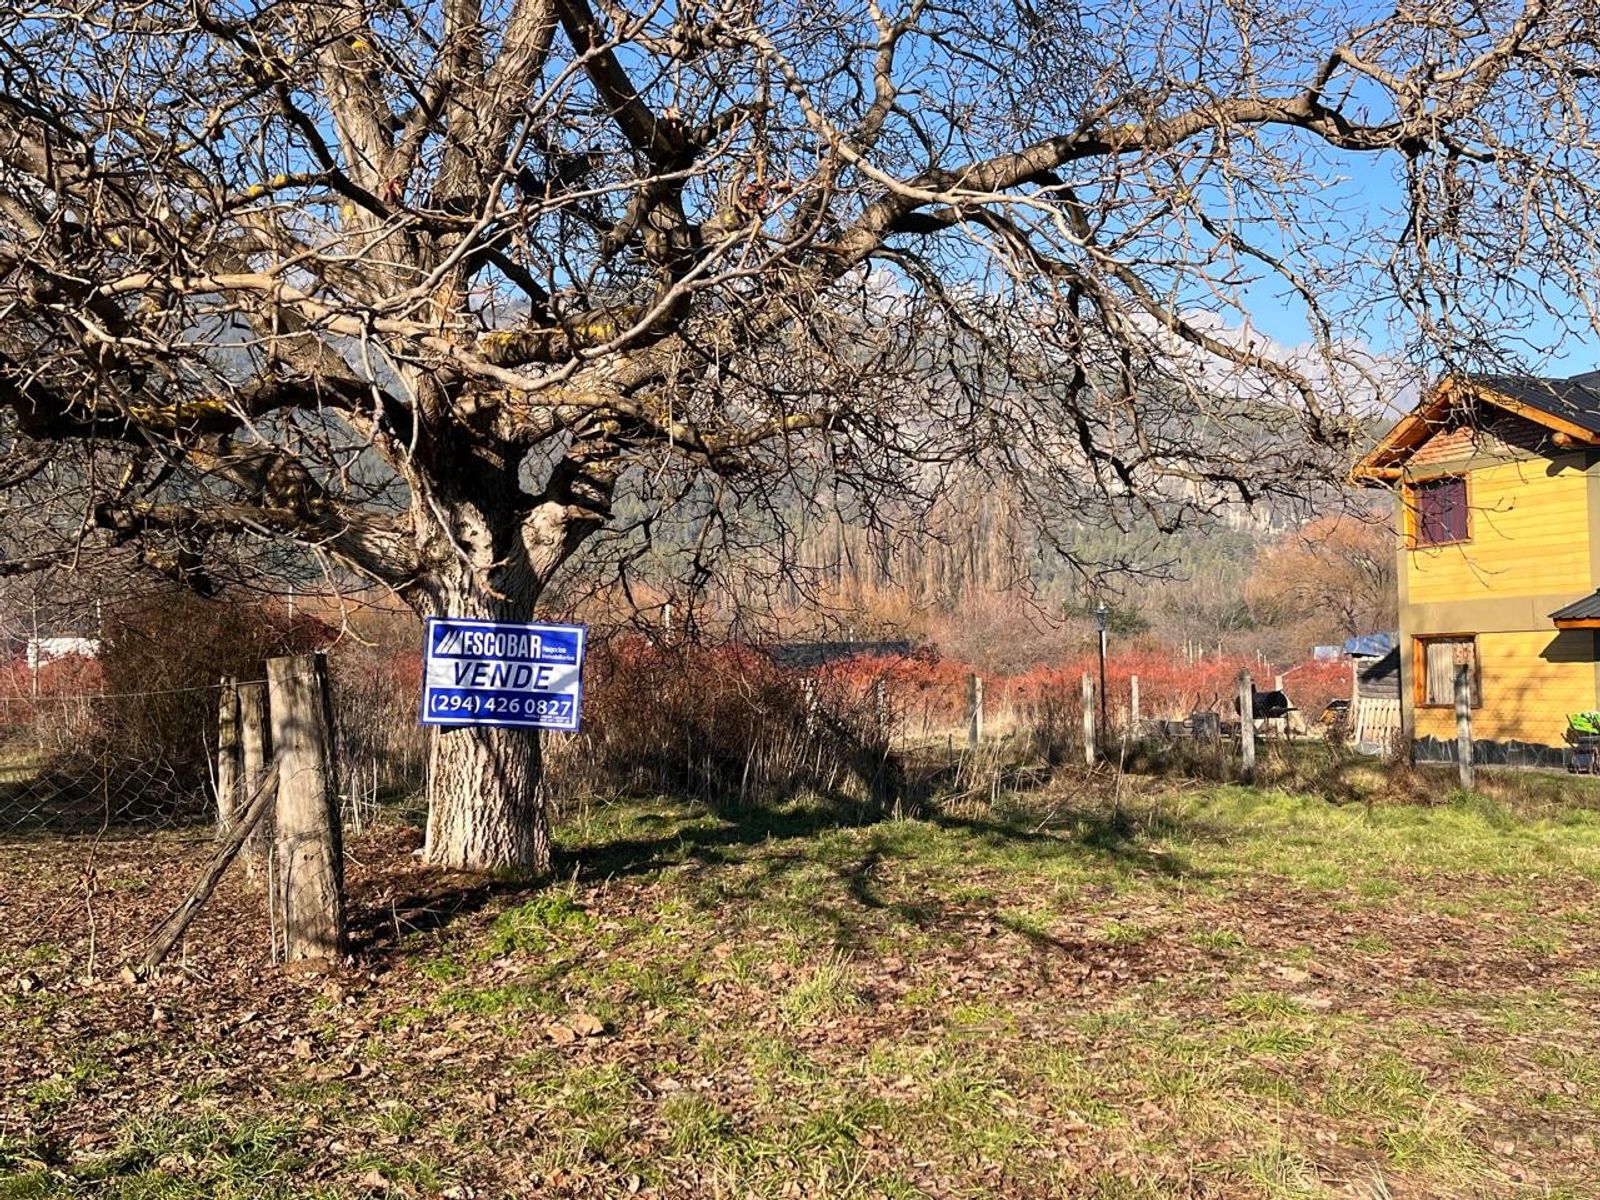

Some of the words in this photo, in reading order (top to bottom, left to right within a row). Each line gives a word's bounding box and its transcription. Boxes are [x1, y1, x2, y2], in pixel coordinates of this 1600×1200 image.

[463, 631, 541, 659] ESCOBAR
[454, 661, 553, 690] VENDE
[431, 694, 480, 713] (294)
[484, 697, 520, 713] 426
[524, 699, 572, 716] 0827
